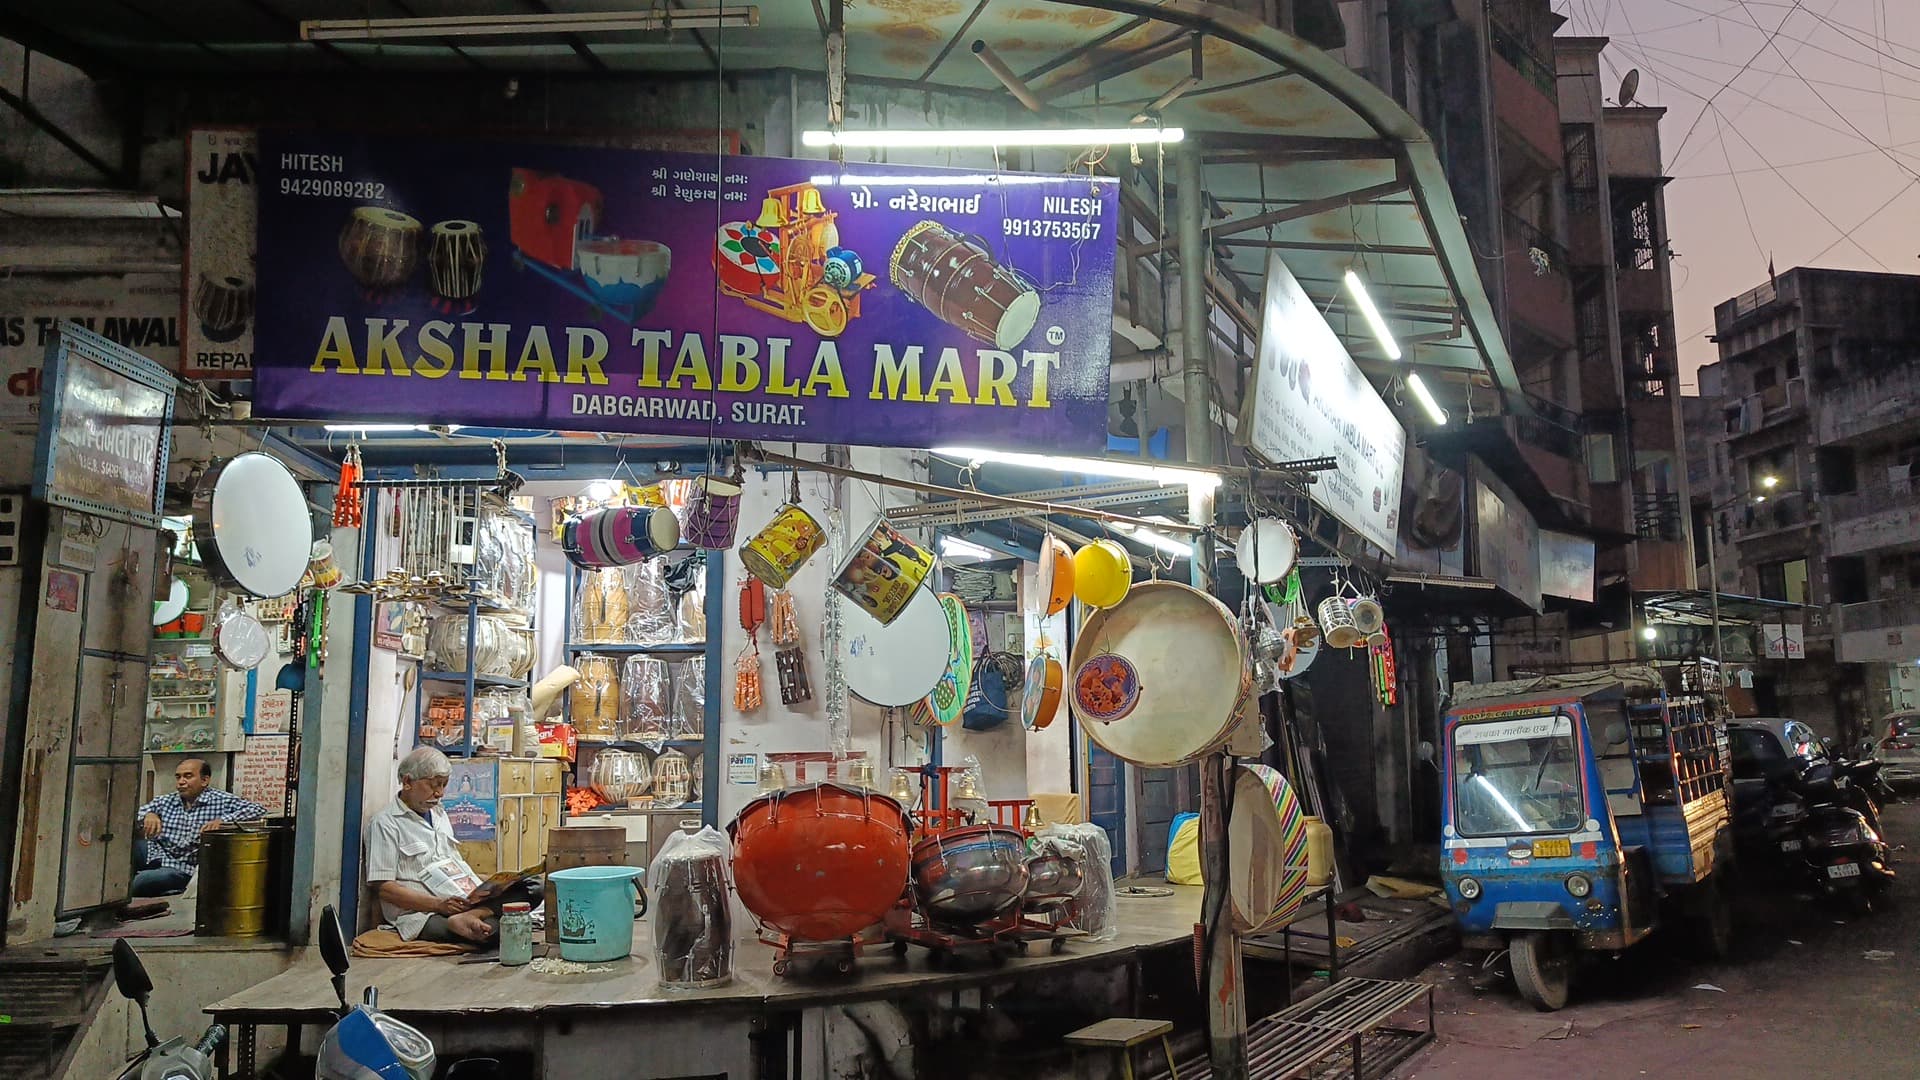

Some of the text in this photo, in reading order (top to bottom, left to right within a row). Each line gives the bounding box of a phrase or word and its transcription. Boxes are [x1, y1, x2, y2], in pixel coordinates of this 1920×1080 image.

[281, 153, 343, 173] HITESH
[280, 178, 386, 200] 9429089282
[889, 188, 982, 215] નરેશભાઈ
[1043, 196, 1102, 216] NILESH
[1003, 218, 1101, 240] 9913753567
[309, 315, 1061, 410] AKSHAR TABLA MART
[571, 393, 807, 427] DABGARWAD, SURAT.
